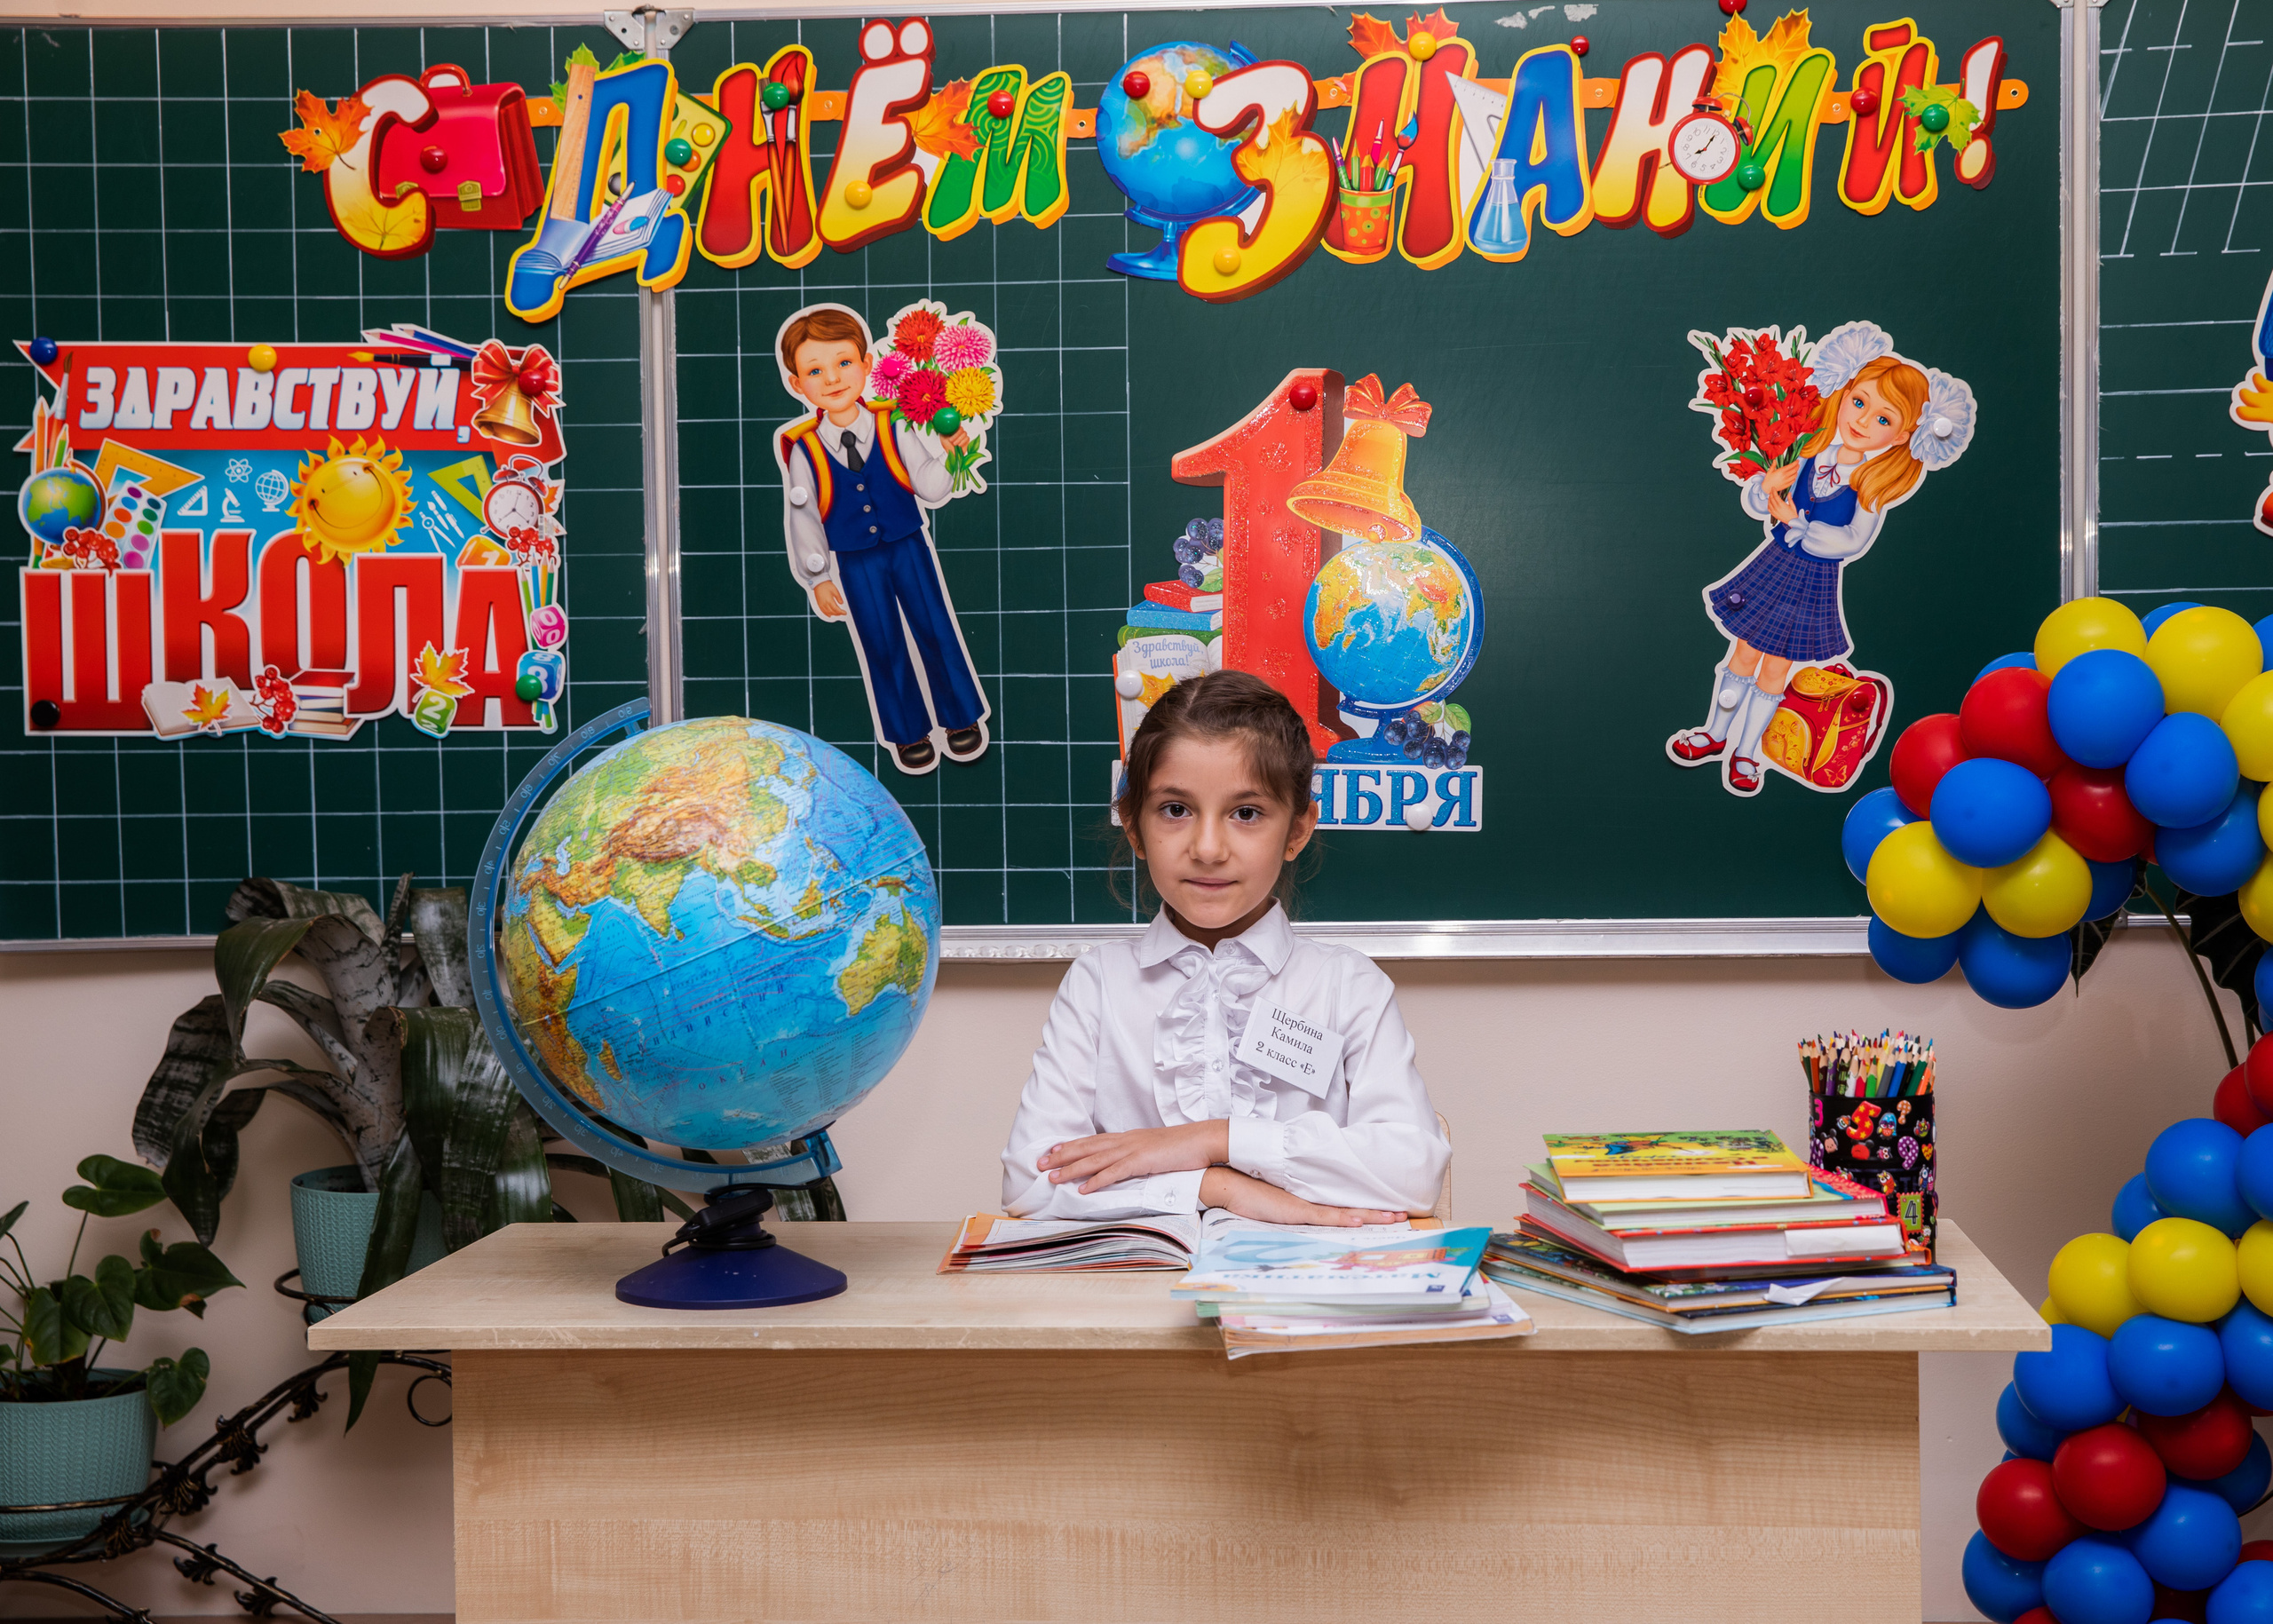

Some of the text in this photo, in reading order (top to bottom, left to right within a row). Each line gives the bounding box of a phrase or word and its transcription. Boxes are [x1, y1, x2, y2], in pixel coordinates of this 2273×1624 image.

[323, 16, 2008, 323] С ДНЁМ ЗНАНИЙ!
[80, 366, 471, 443] ЗДРАВСТВУЙ,
[1171, 368, 1358, 764] 1
[23, 530, 541, 730] ШКОЛА
[1132, 638, 1204, 659] Здравствуй,
[1150, 655, 1190, 669] школа!
[1271, 1008, 1323, 1041] Щербина
[1271, 1026, 1313, 1054] Камила
[1255, 1041, 1316, 1075] 2 класс «Е»
[1814, 1098, 1824, 1128] 3
[1846, 1100, 1882, 1140] 5
[1897, 1136, 1920, 1170] 9
[1905, 1200, 1918, 1225] 4
[1223, 1271, 1442, 1281] Математика
